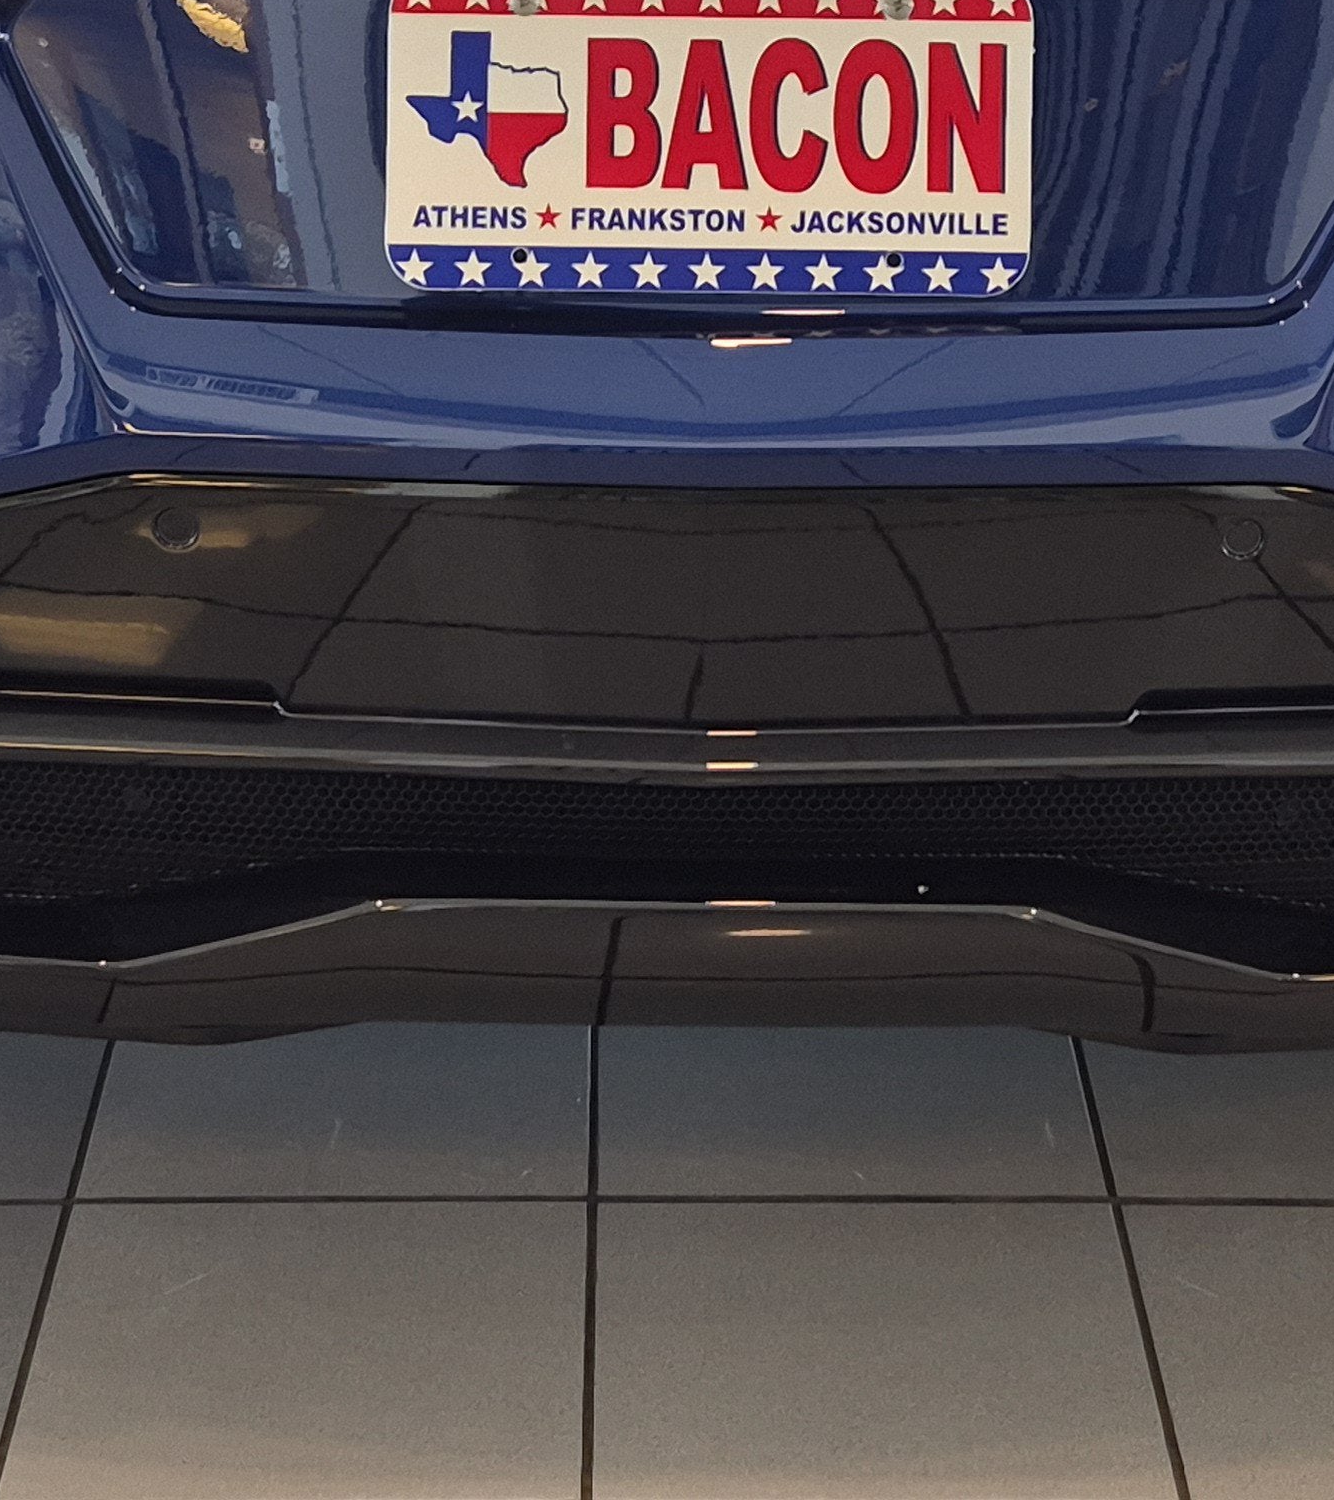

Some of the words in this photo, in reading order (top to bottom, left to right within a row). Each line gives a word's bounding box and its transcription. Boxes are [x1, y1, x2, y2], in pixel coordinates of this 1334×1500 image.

[586, 37, 1007, 194] BACON
[413, 205, 527, 230] ATHENS
[571, 207, 745, 232] FRANKSTON
[790, 210, 1008, 236] JACKSONVILLE
